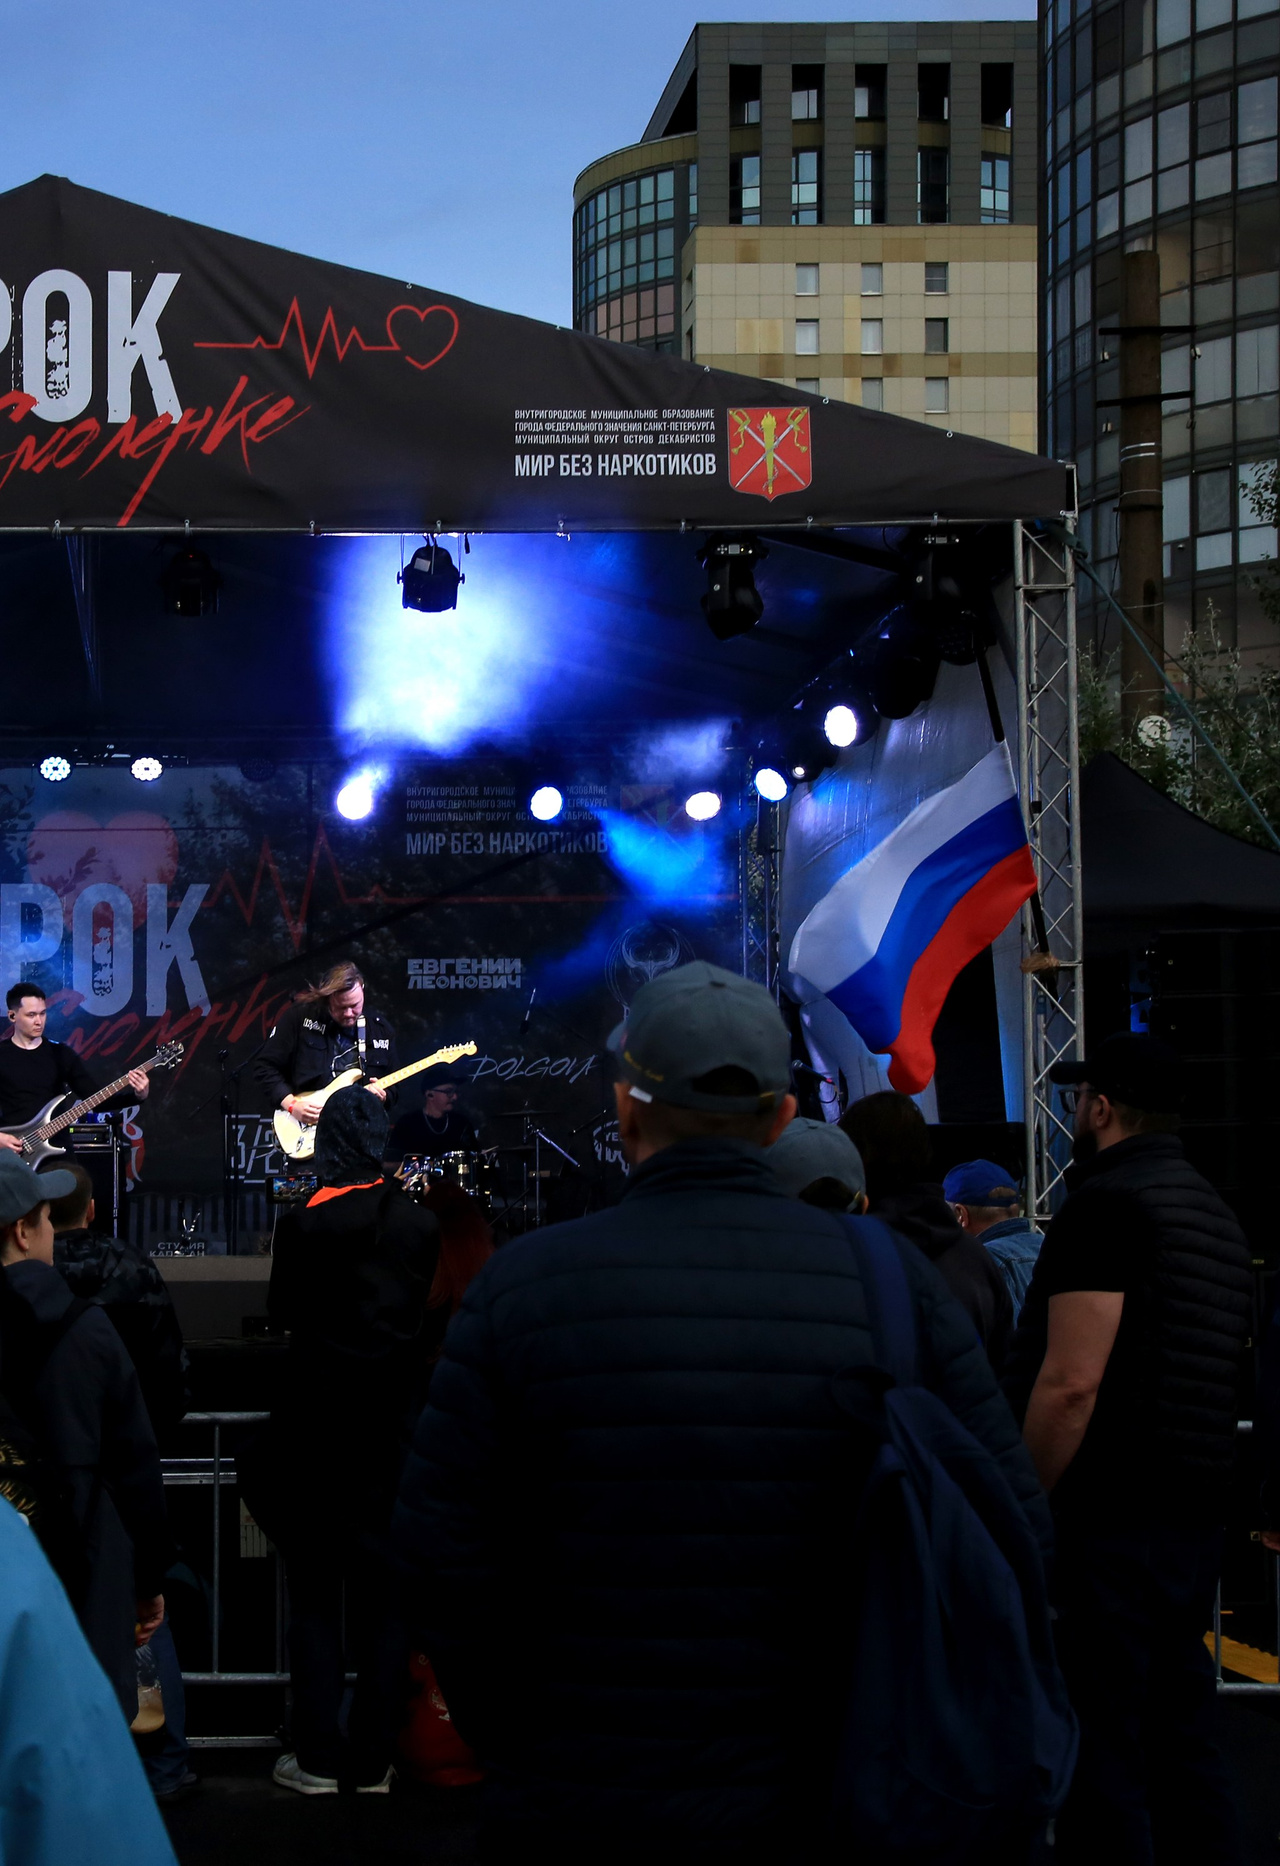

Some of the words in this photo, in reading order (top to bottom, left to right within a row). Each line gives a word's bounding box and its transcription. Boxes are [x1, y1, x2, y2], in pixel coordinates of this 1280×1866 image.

[514, 408, 587, 420] ВНУТРИГОРОДСКОЕ
[590, 408, 658, 420] МУНИЦИПАЛЬНОЕ
[662, 408, 715, 419] ОБРАЗОВАНИЕ
[514, 421, 544, 432] ГОРОДА
[545, 421, 603, 432] ФЕДЕРАЛЬНОГО
[604, 421, 642, 432] ЗНАЧЕНИЯ
[643, 421, 716, 432] САНКТ-ПЕТЕРБУРГА
[514, 433, 590, 445] МУНИЦИПАЛЬНЫЙ
[593, 434, 619, 445] ОКРУГ
[623, 434, 654, 445] ОСТРОВ
[658, 433, 716, 445] ДЕКАБРИСТОВ
[514, 453, 555, 477] МИР
[559, 453, 593, 477] БЕЗ
[597, 453, 717, 476] НАРКОТИКОВ
[485, 812, 511, 822] ОКРУГ
[406, 832, 447, 855] МИР
[450, 832, 484, 855] БЕЗ
[488, 831, 609, 854] НАРКОТИКОВ
[0, 882, 212, 1018] РОК
[407, 974, 522, 990] ЛЕОНОВИЧ
[157, 1241, 205, 1250] СТУИЯ
